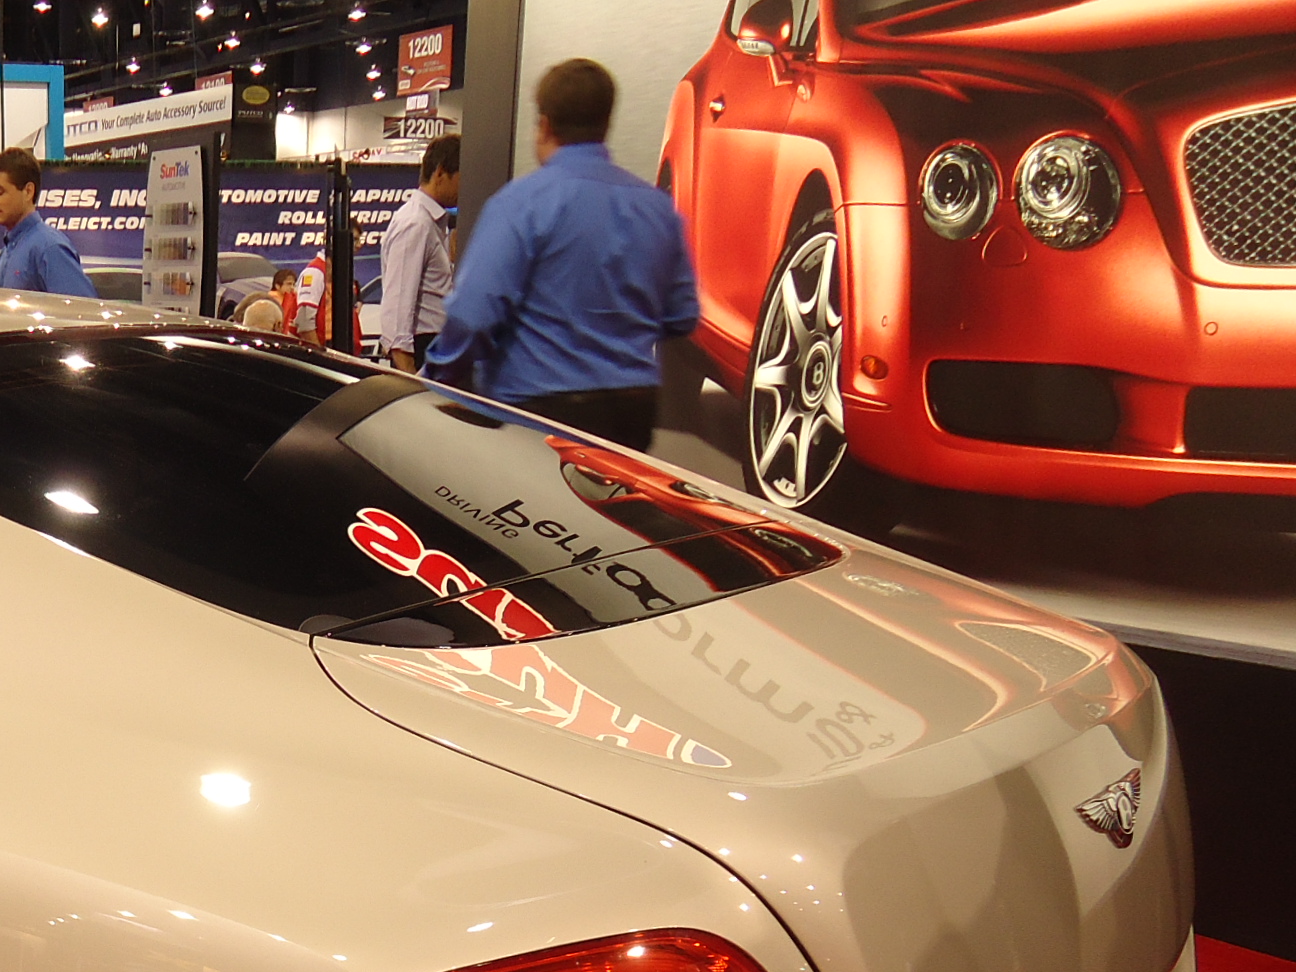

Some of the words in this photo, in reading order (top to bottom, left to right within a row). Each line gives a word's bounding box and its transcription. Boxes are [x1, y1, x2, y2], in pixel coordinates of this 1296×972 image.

[408, 33, 443, 59] 12200
[101, 116, 116, 131] Your
[116, 112, 145, 131] Complete
[145, 108, 162, 123] Auto
[162, 103, 198, 120] Accessory
[198, 96, 227, 112] Source!
[398, 118, 444, 138] 12200
[160, 161, 189, 180] SunTek
[220, 189, 320, 204] TOMOTIVE
[278, 210, 326, 225] ROLL
[235, 231, 297, 247] PAINT
